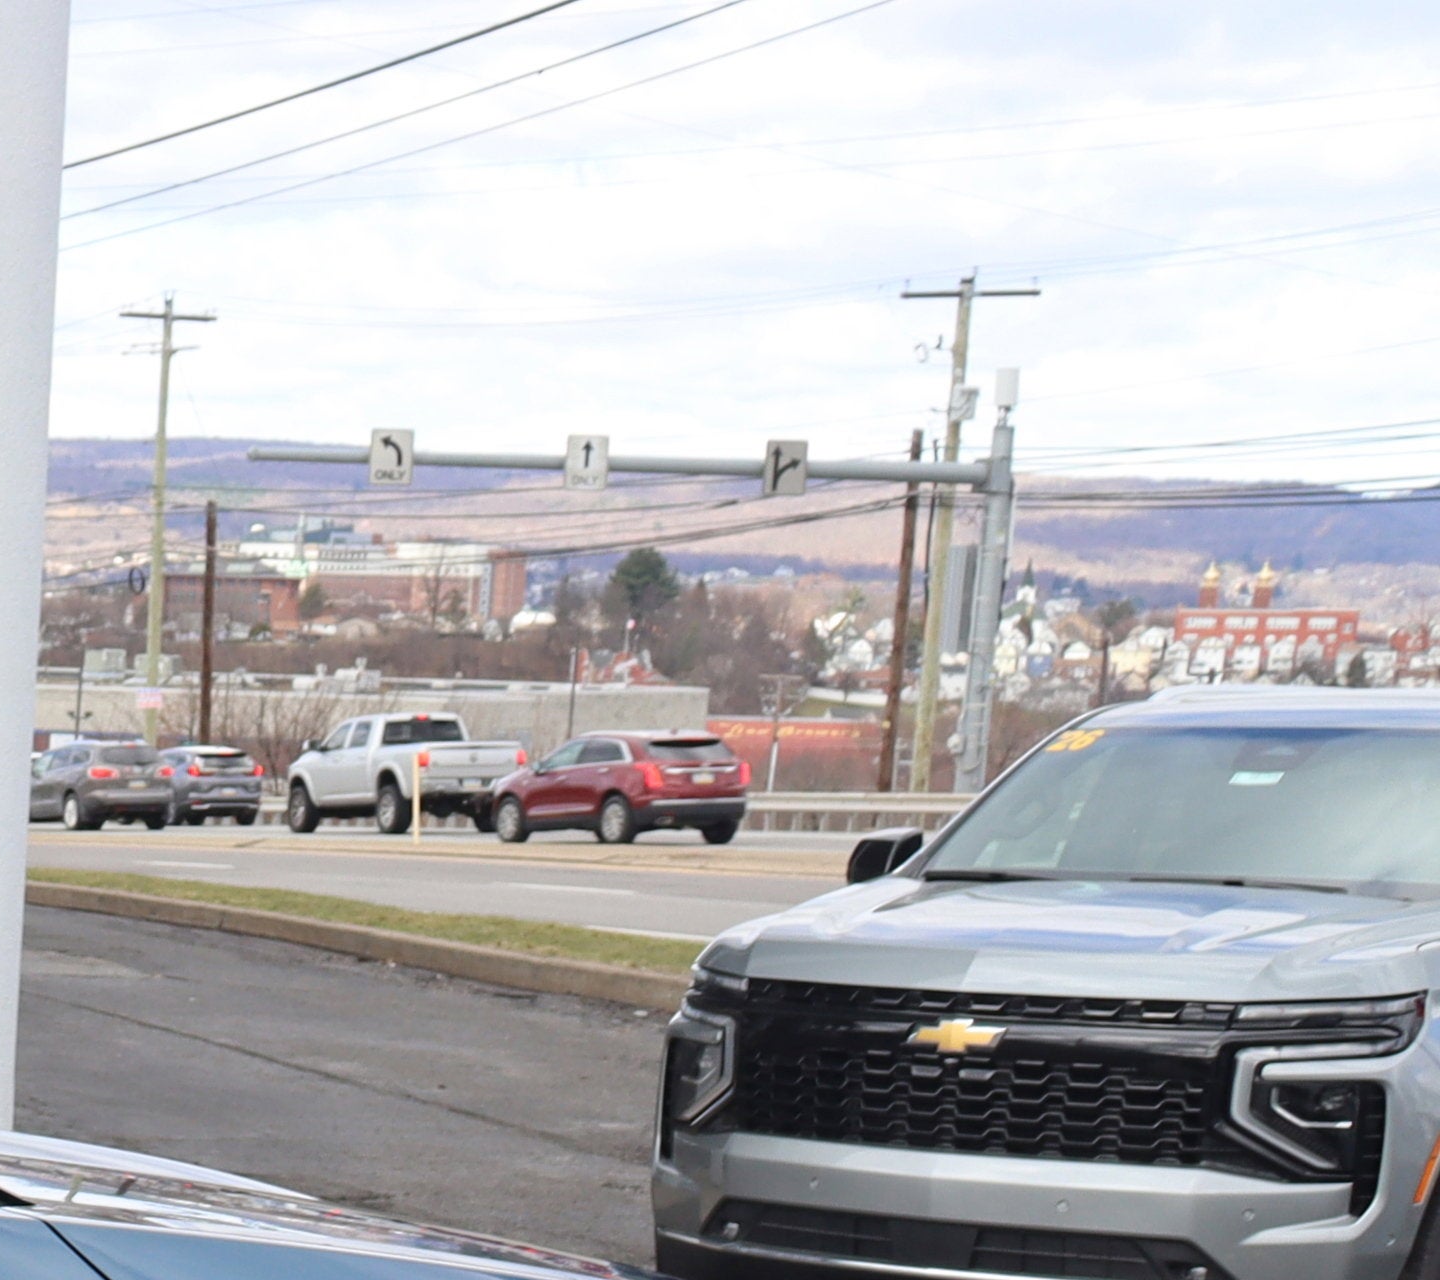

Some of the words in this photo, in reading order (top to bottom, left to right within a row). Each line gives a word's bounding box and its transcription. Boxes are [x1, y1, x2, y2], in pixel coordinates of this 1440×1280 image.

[374, 470, 406, 481] ONLY
[571, 475, 599, 486] ONLY
[1044, 728, 1106, 751] 26
